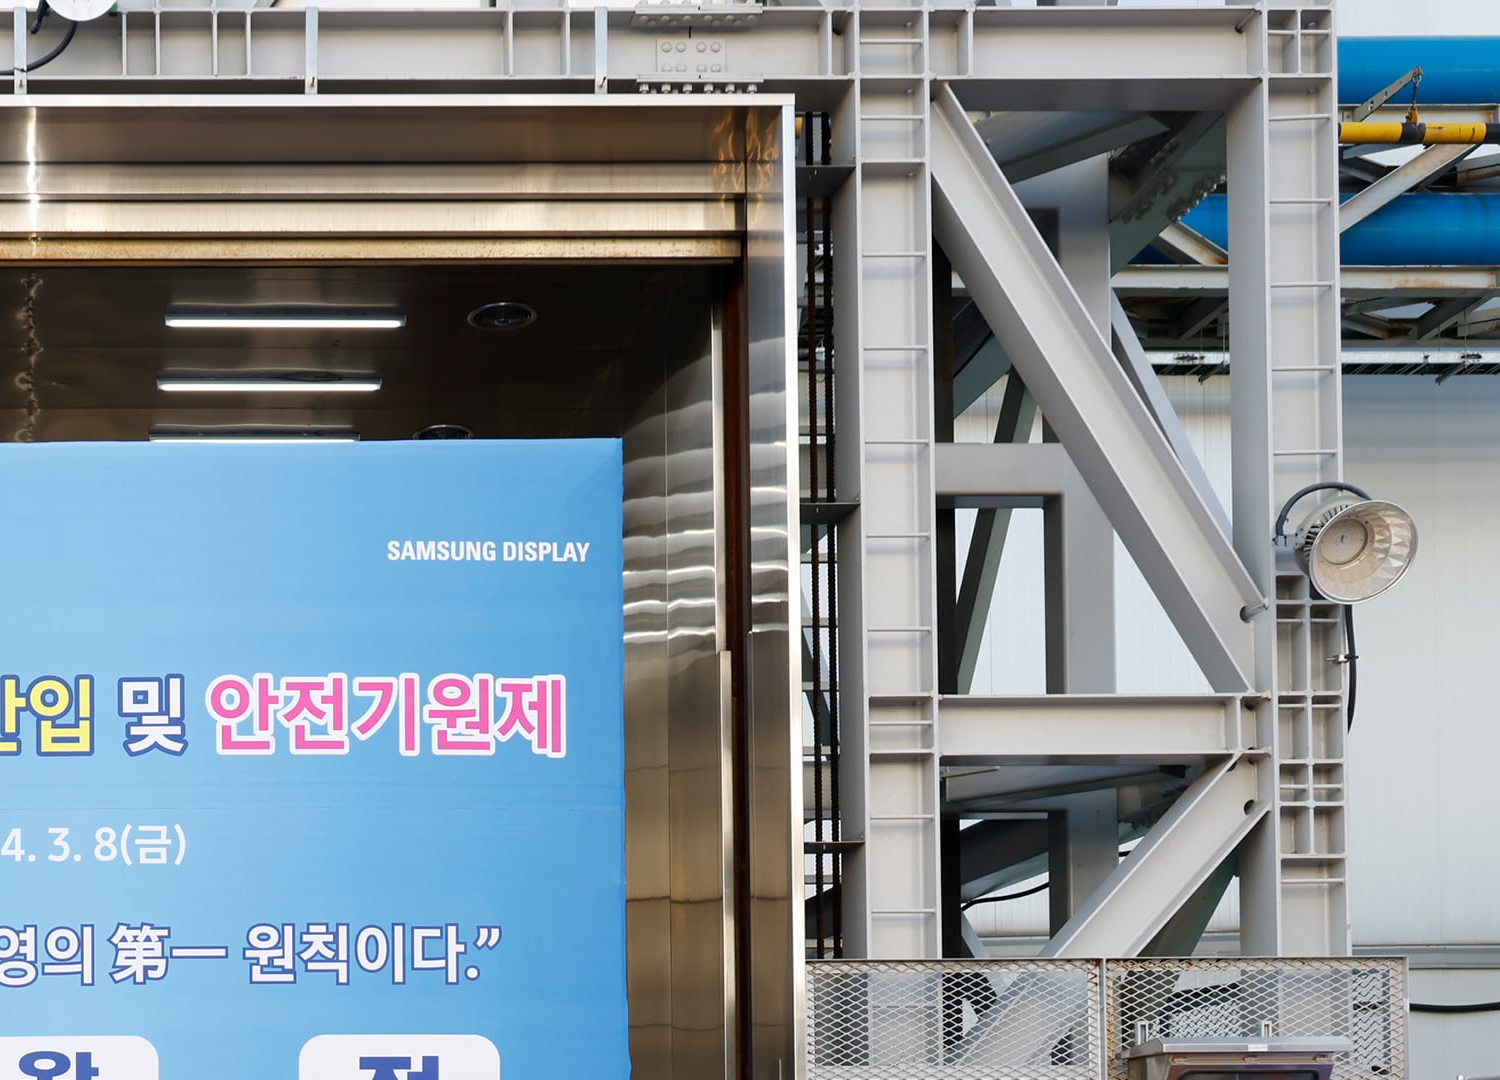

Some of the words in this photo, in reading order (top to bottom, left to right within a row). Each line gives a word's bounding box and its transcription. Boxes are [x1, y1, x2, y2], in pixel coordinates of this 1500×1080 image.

[387, 540, 496, 561] SAMSUNG
[503, 541, 590, 562] DISPLAY
[117, 673, 188, 756] 및
[205, 672, 566, 758] 안전기원제
[47, 827, 82, 863] 3.
[93, 823, 187, 866] 8(금)
